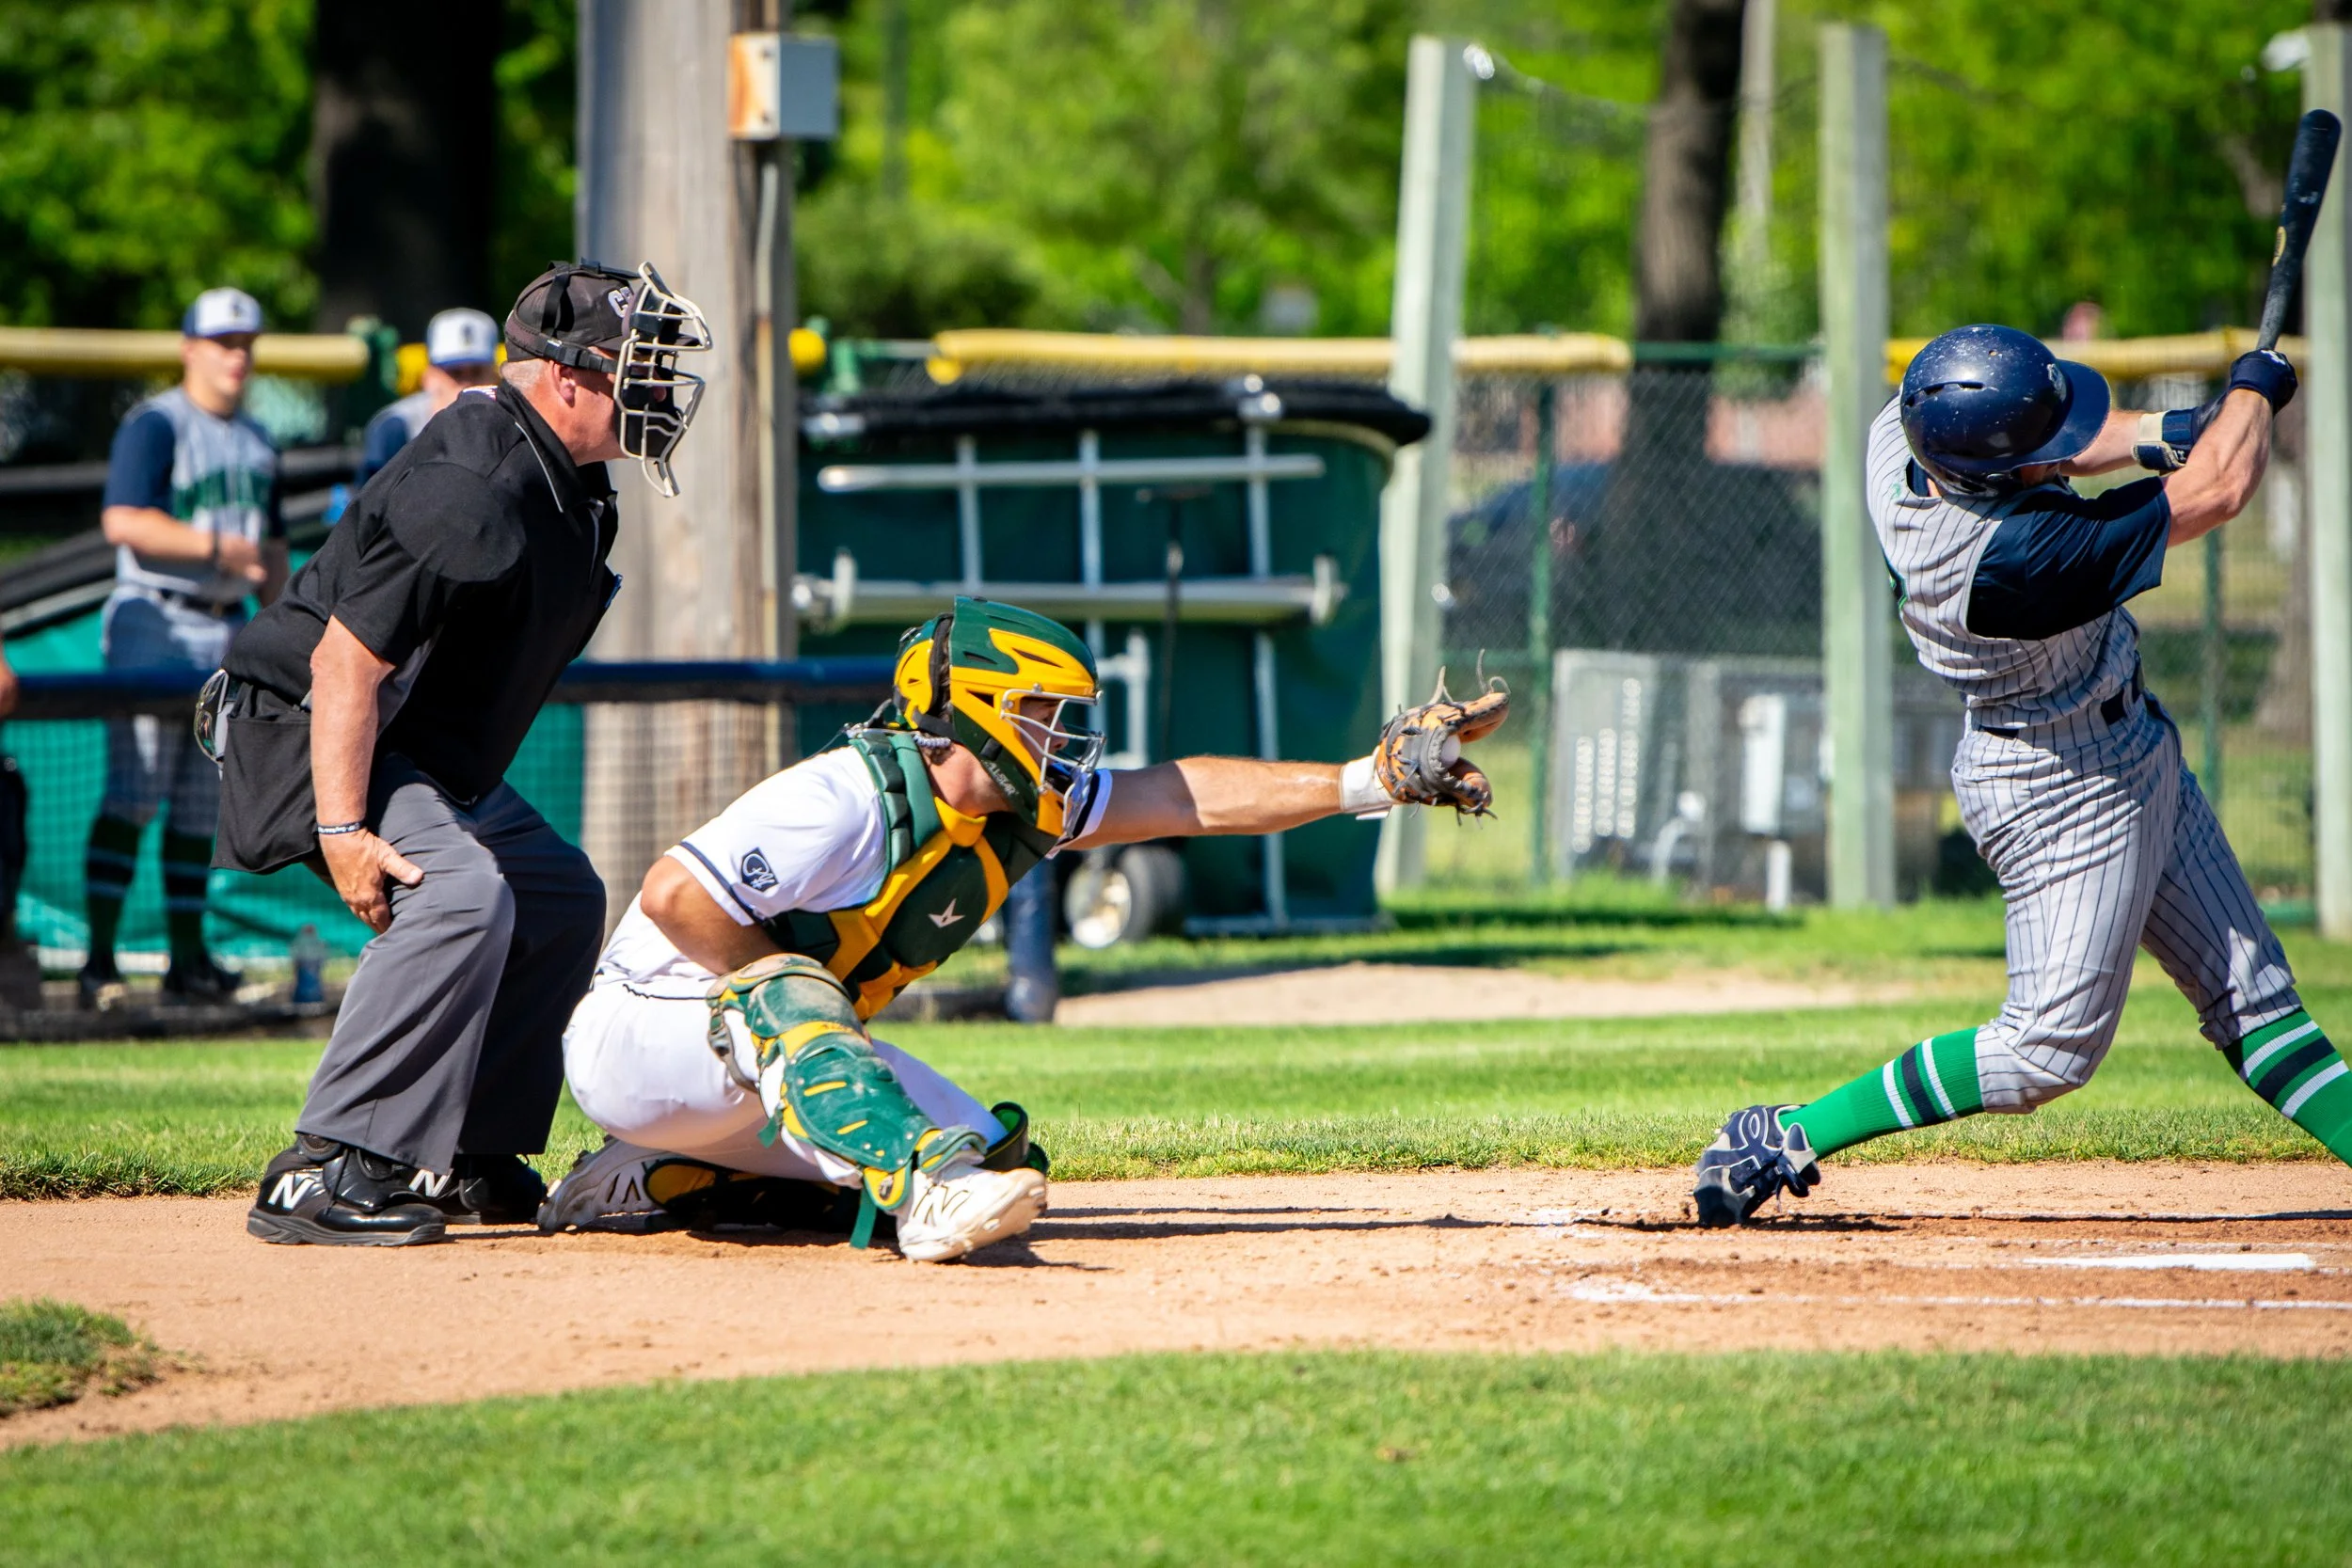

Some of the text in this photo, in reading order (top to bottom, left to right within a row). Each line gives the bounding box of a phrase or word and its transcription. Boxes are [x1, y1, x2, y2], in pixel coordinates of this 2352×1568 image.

[268, 1173, 315, 1210] N
[408, 1168, 453, 1197] N
[913, 1183, 973, 1227] N
